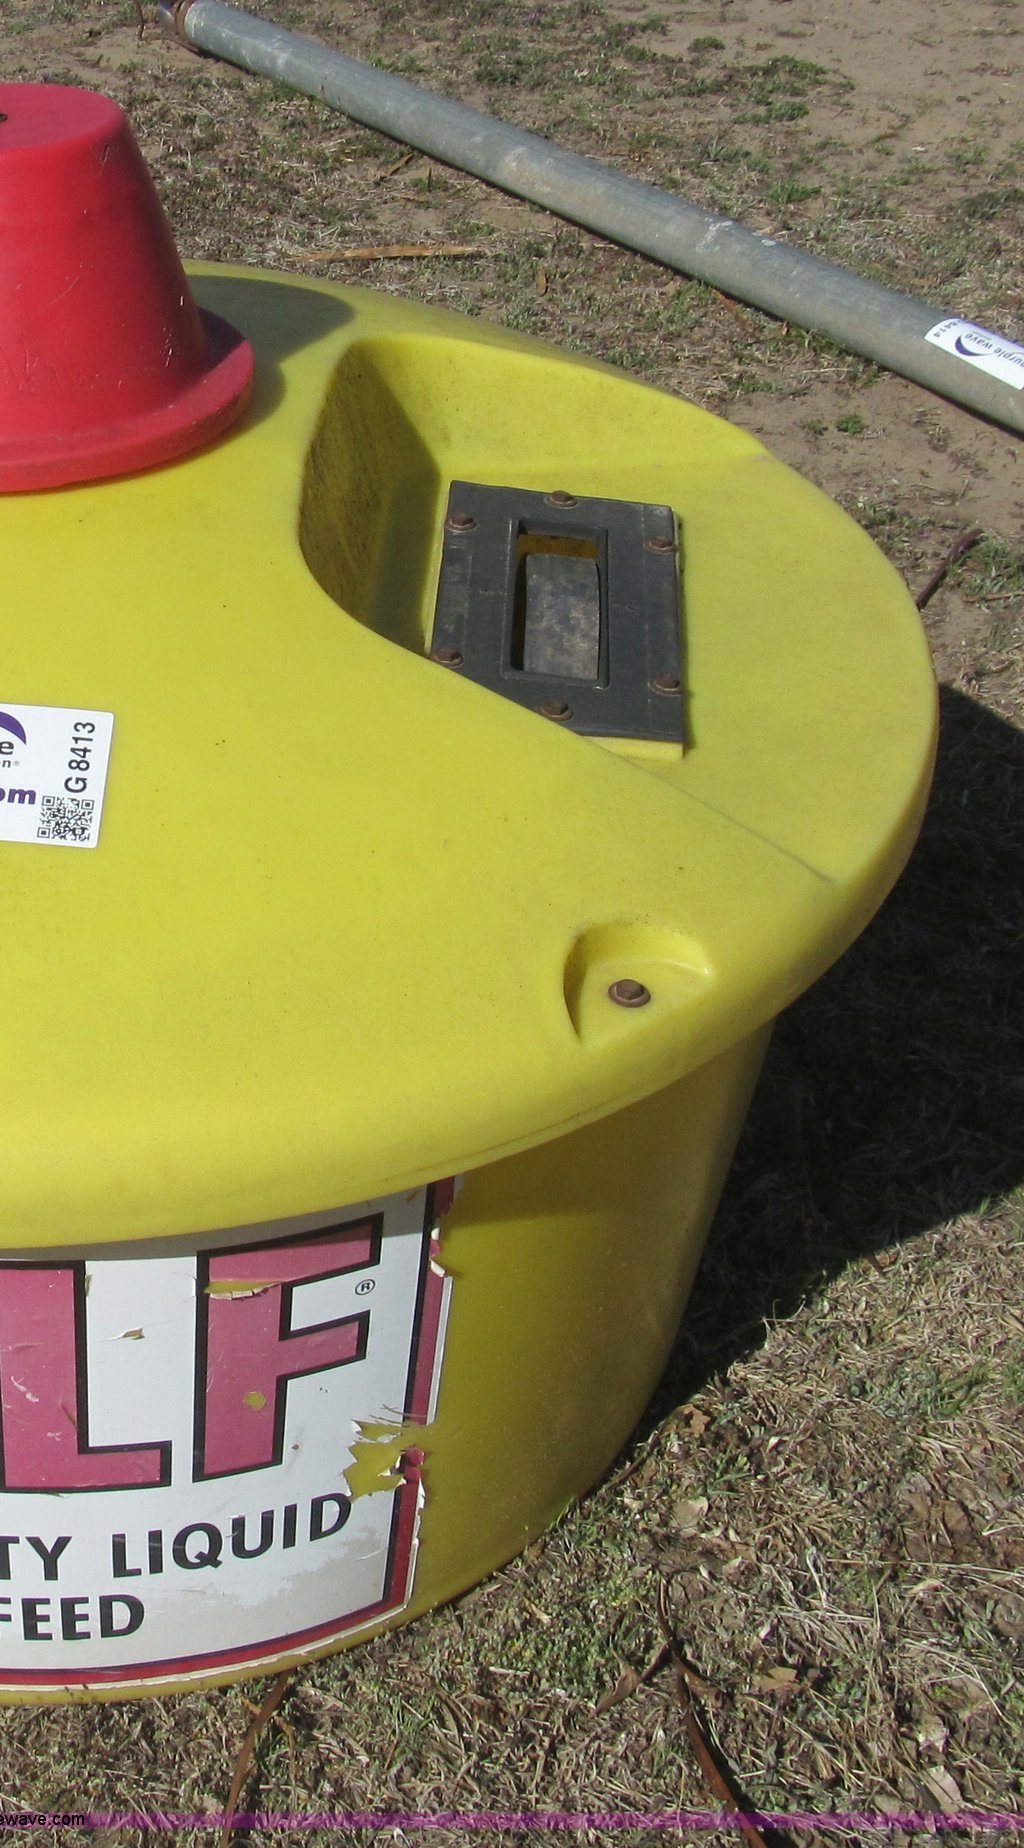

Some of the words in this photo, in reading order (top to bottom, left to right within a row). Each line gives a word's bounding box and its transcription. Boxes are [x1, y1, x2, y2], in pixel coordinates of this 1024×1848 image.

[965, 333, 993, 349] wave
[68, 722, 95, 771] 8413
[64, 776, 88, 793] G
[111, 1492, 353, 1579] LIQUID
